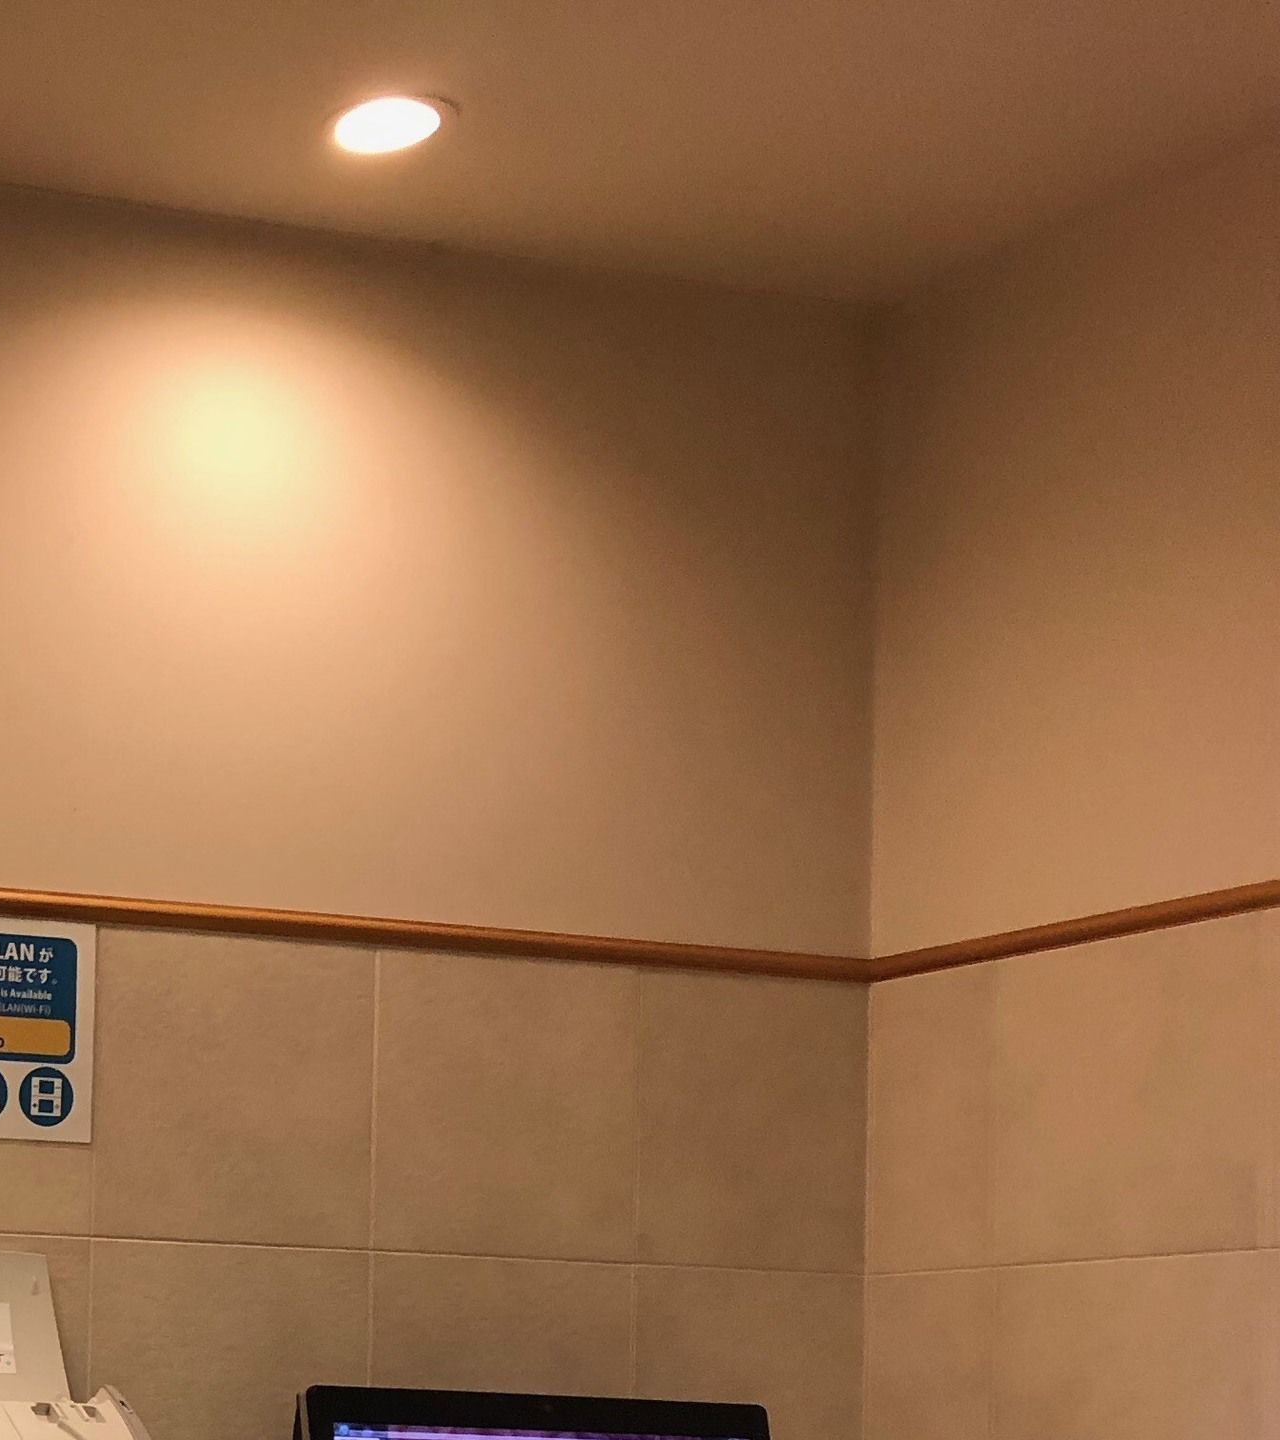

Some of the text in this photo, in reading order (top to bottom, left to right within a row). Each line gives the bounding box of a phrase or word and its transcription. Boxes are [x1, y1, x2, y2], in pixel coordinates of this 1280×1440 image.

[39, 947, 53, 963] が
[0, 987, 8, 997] is
[9, 988, 53, 1000] Available
